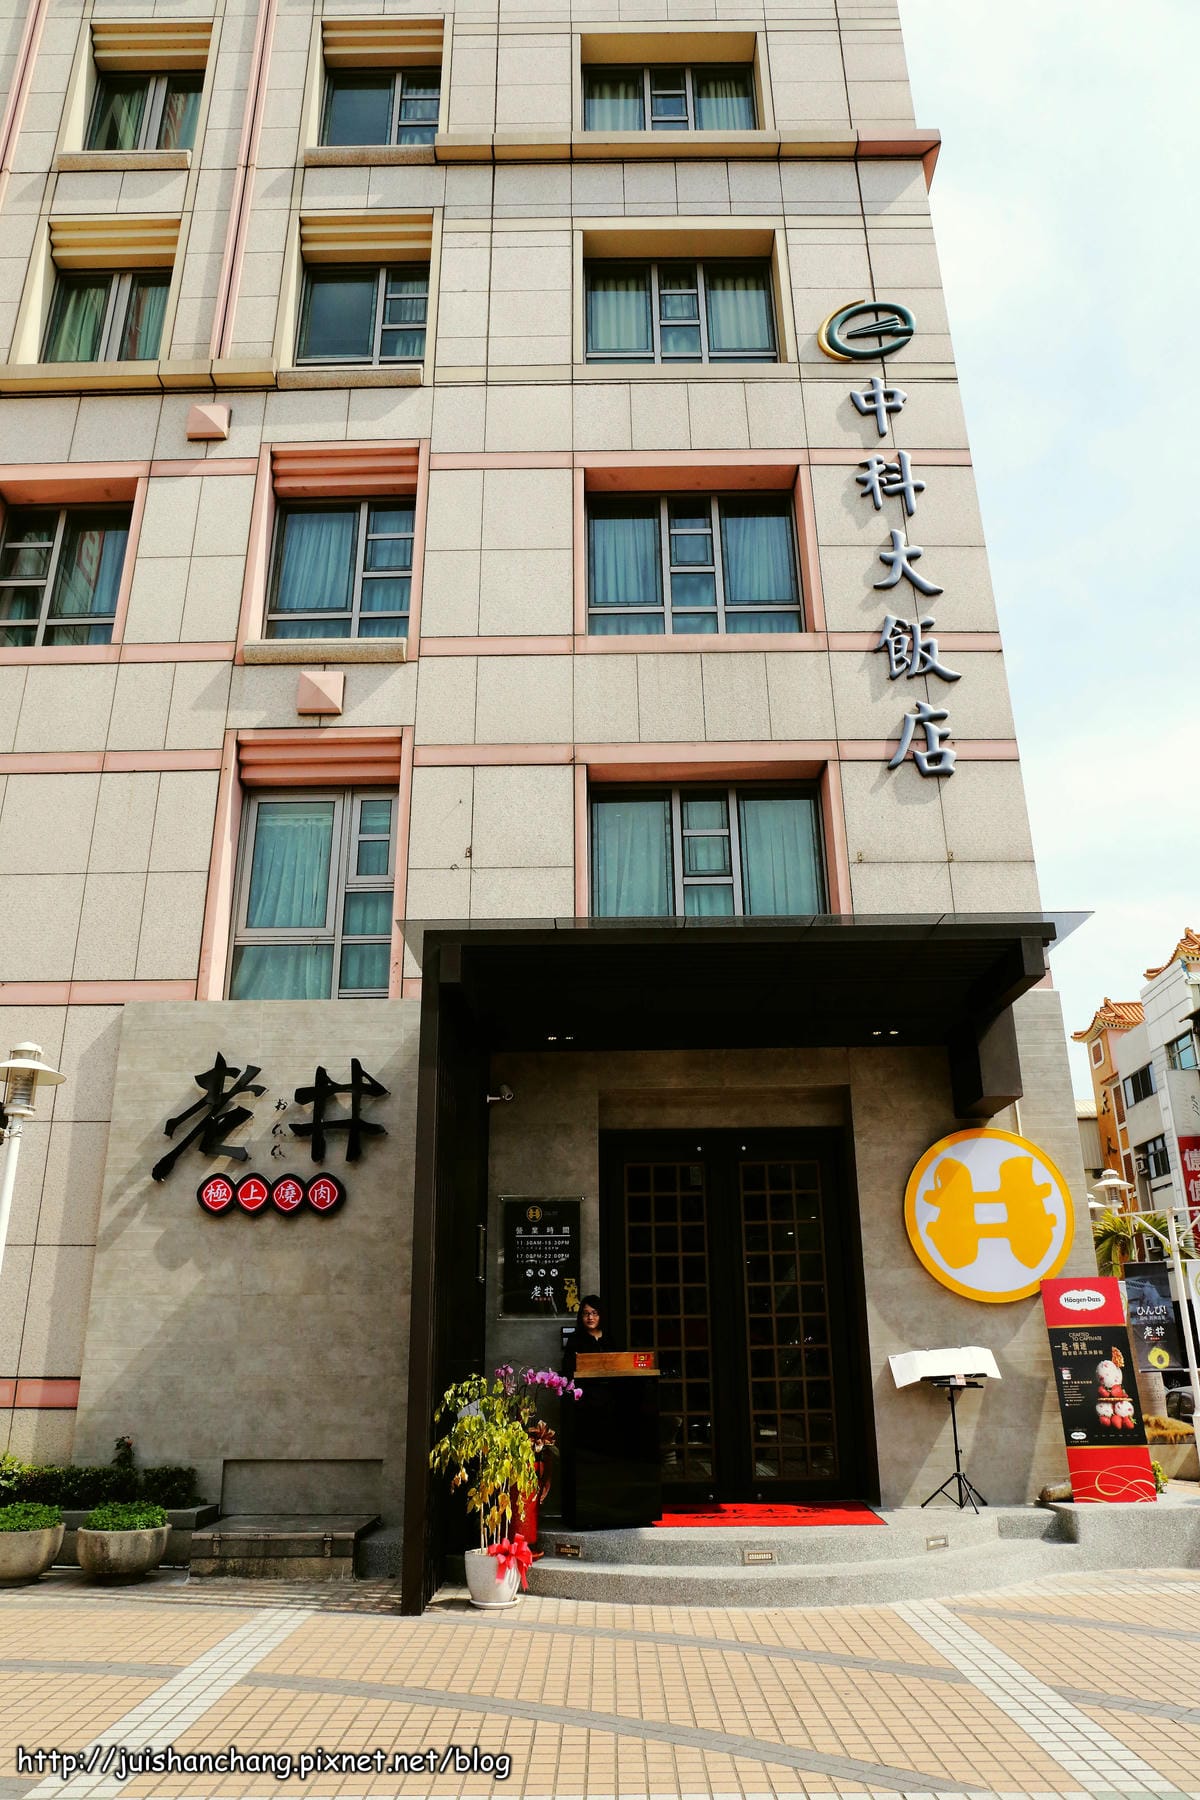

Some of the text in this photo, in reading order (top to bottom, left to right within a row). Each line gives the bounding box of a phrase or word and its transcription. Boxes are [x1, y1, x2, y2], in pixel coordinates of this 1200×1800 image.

[849, 376, 962, 778] 中科大飯店
[152, 1051, 391, 1181] 老井
[204, 1181, 336, 1207] 極上燒肉
[531, 1286, 554, 1299] 老井
[1144, 1326, 1165, 1339] 老井
